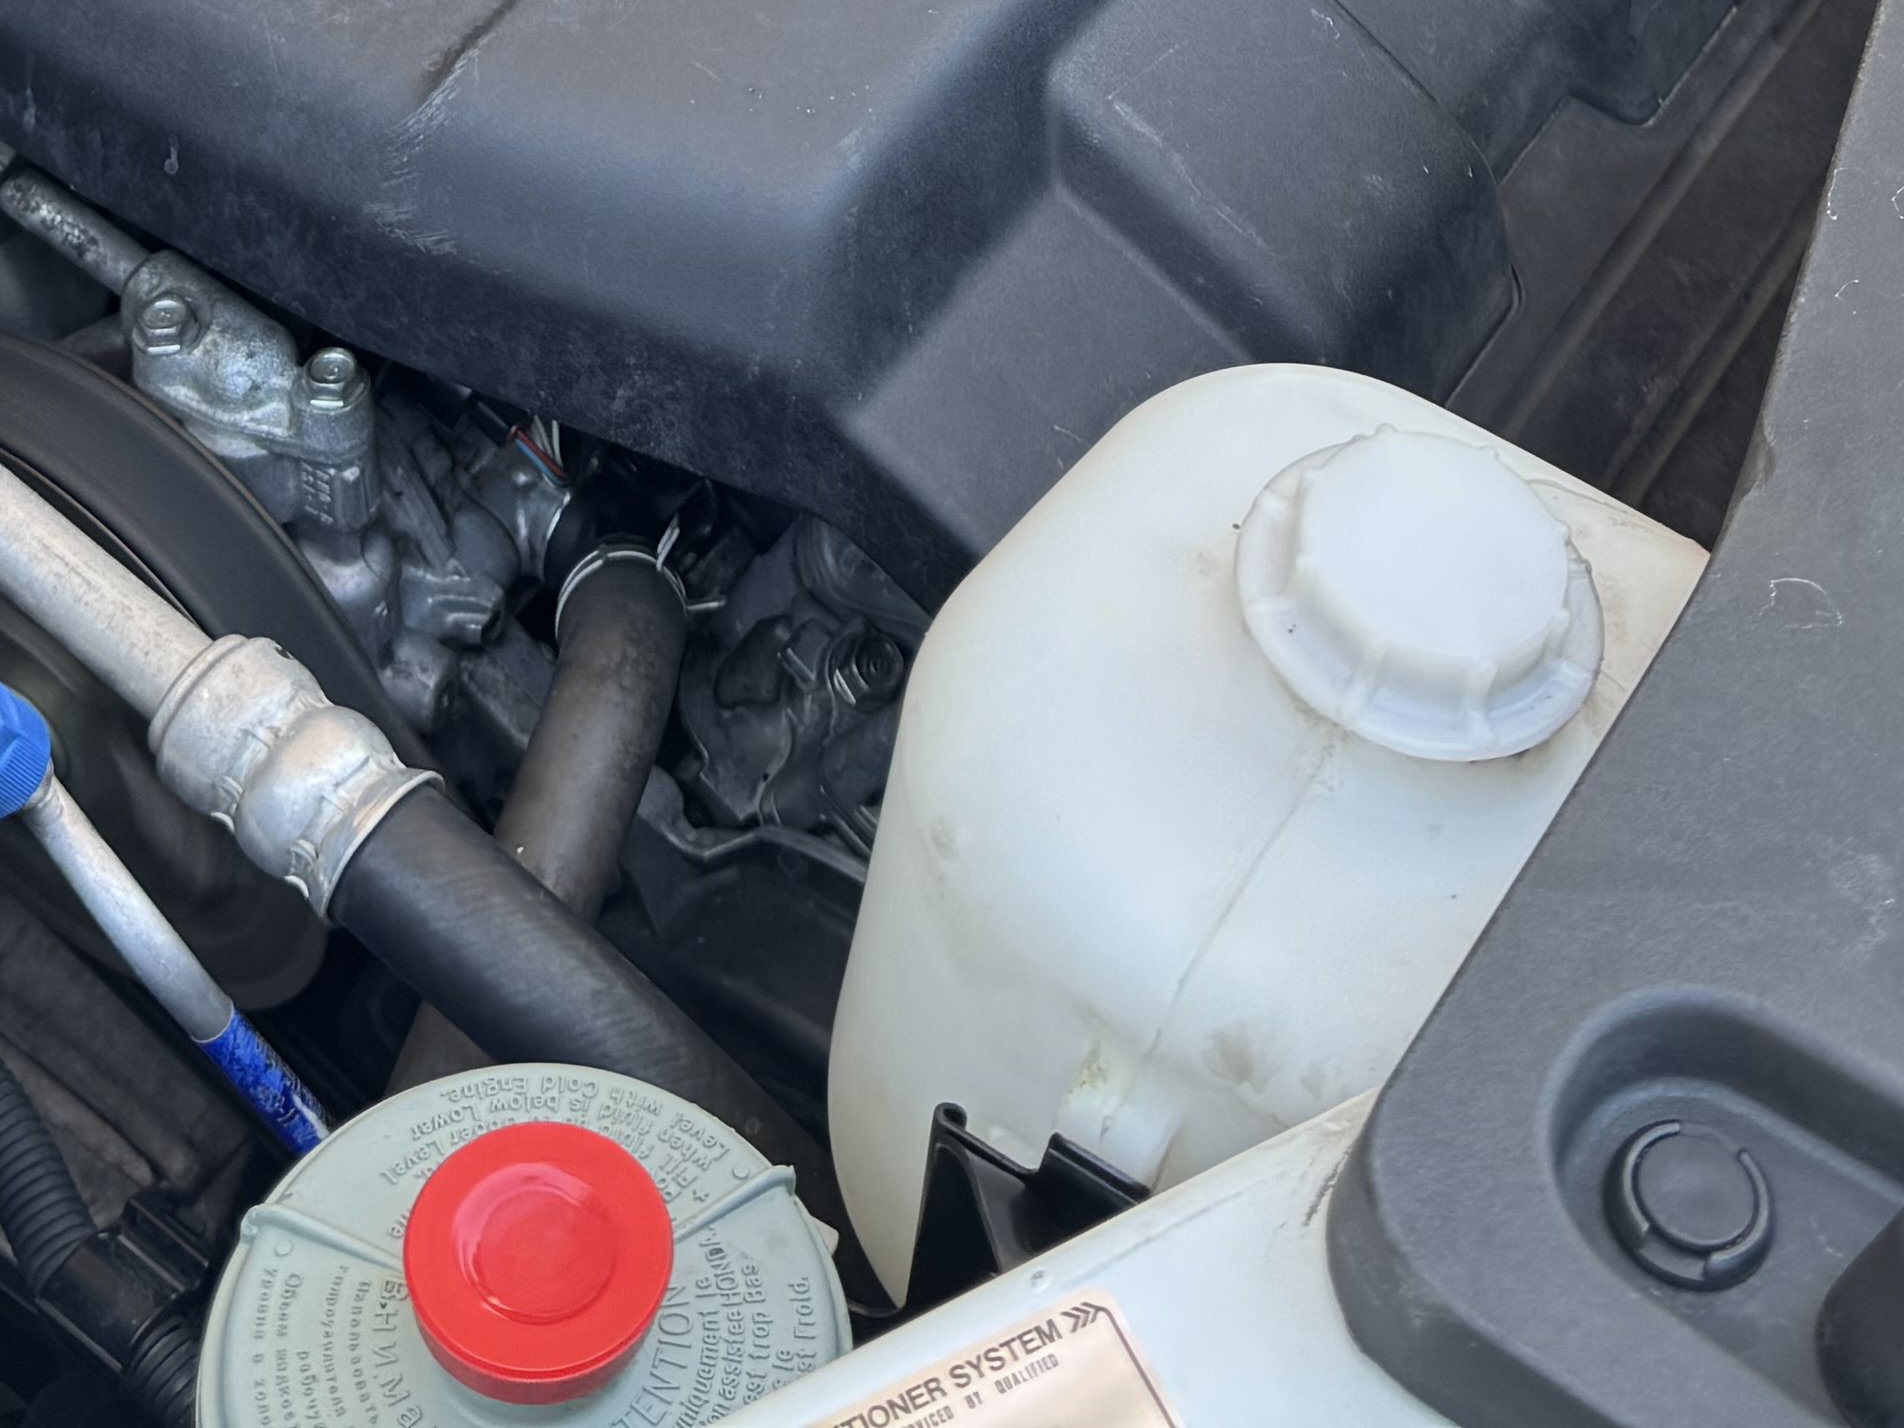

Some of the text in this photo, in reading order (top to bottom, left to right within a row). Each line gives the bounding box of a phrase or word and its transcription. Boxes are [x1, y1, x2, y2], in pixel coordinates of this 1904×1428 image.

[410, 1094, 712, 1172] when fluid is below Lower
[440, 1077, 730, 1162] Level with Cold Engine.
[380, 1141, 444, 1185] Level
[741, 1264, 766, 1304] Bas
[748, 1312, 774, 1360] trop
[948, 1318, 1063, 1389] SYSTEM
[964, 1391, 984, 1410] BY
[994, 1353, 1060, 1395] QUALIFIED
